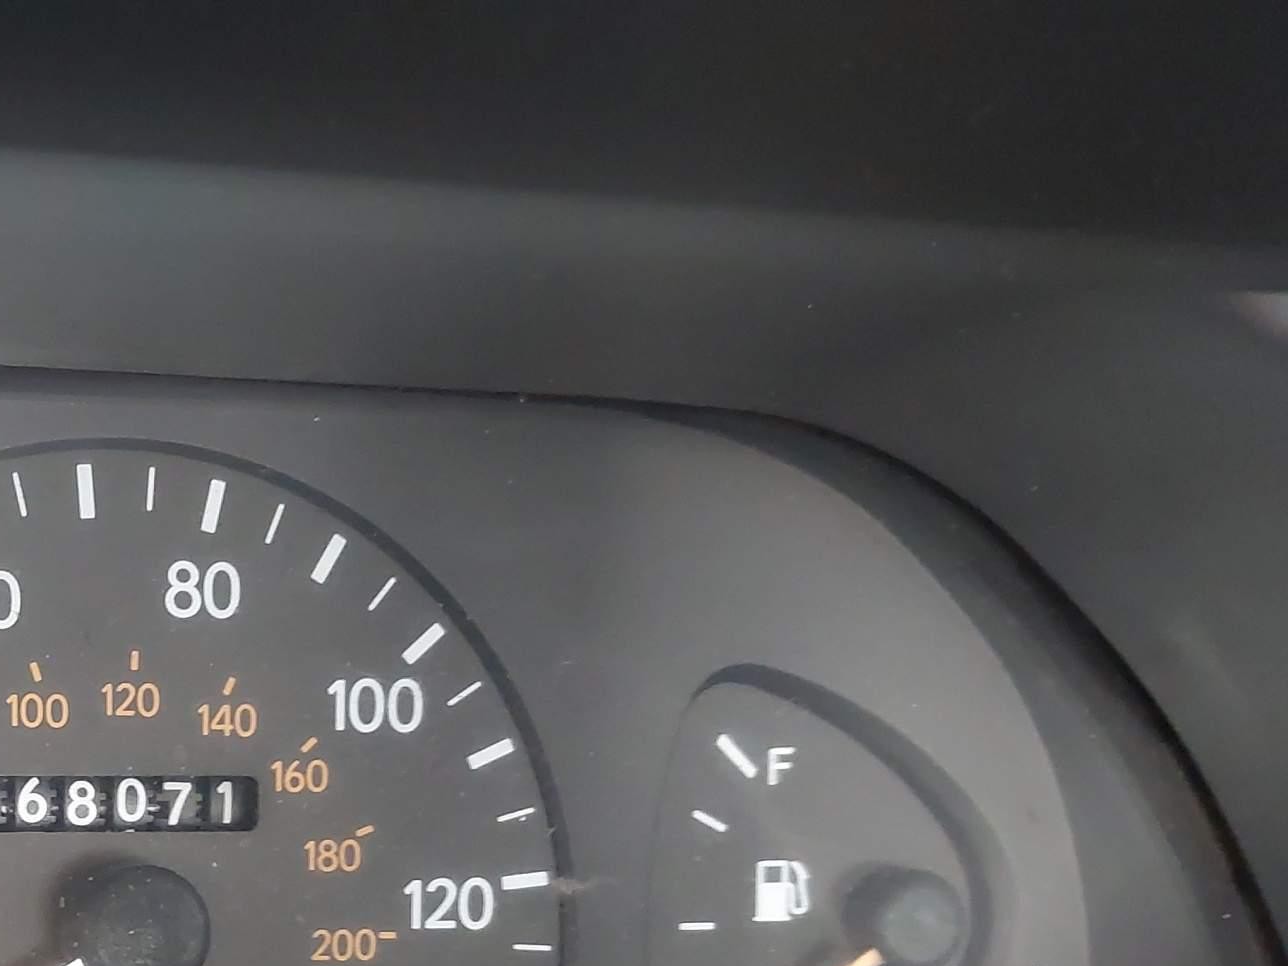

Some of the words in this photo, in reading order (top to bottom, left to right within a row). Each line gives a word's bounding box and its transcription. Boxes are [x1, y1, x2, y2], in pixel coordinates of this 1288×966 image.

[165, 561, 240, 619] 80
[7, 693, 68, 728] 100
[102, 683, 159, 717] 120
[328, 678, 423, 733] 100
[198, 704, 257, 738] 140
[271, 760, 328, 793] 160
[768, 747, 795, 785] F
[304, 839, 361, 872] 180
[404, 877, 494, 930] 120
[311, 929, 376, 961] 200
